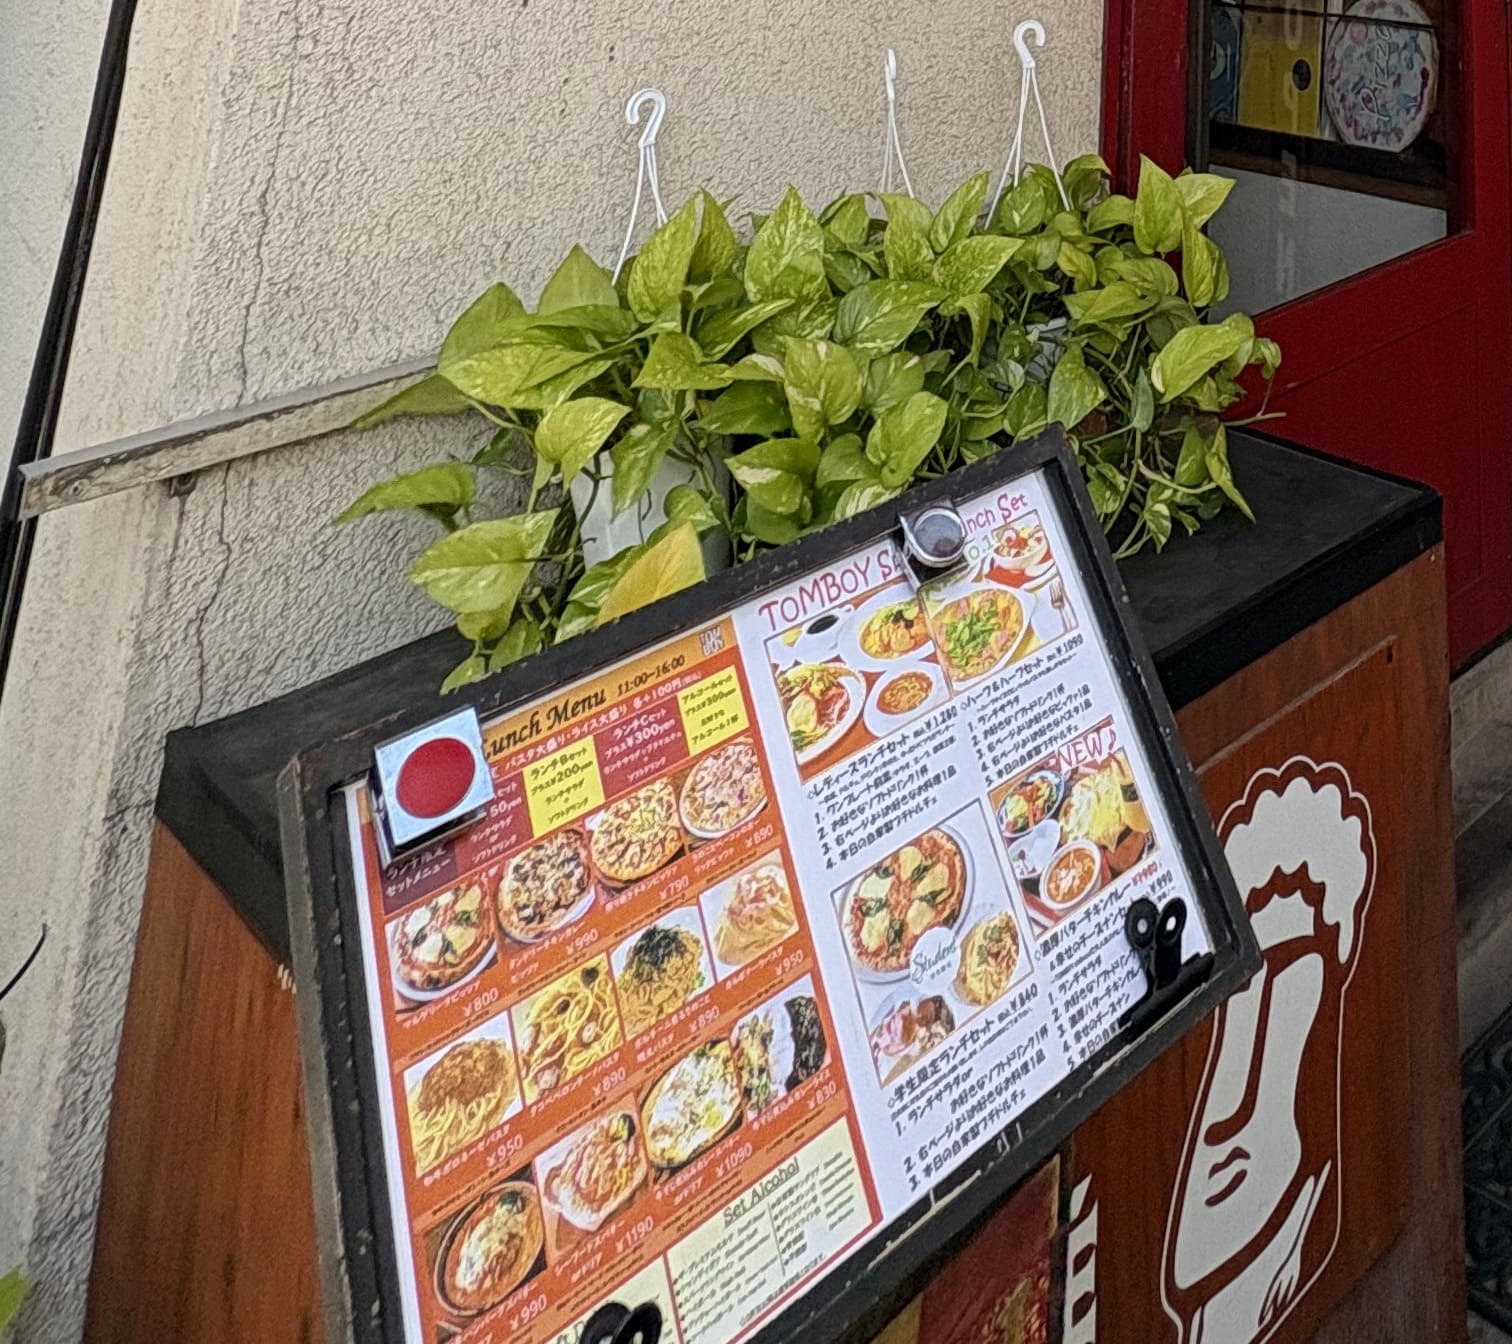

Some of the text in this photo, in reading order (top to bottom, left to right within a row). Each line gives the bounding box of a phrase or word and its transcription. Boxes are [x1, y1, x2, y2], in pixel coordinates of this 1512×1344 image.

[757, 551, 877, 635] TOMBOY
[995, 487, 1028, 524] Set
[544, 685, 606, 730] Menu
[812, 731, 910, 797] レディースランチセット
[1051, 726, 1108, 773] NEW
[659, 874, 689, 901] ¥790
[565, 926, 599, 956] ¥990
[774, 948, 804, 976] ¥950
[463, 987, 498, 1017] ¥800
[689, 1004, 720, 1033] ¥890
[892, 1015, 995, 1104] 学生限定ランチセット
[1009, 982, 1039, 1013] ¥840
[592, 1065, 626, 1098] ¥890
[807, 1079, 837, 1109] ¥830
[486, 1132, 524, 1169] ¥950
[715, 1141, 753, 1179] ¥1090
[720, 1196, 747, 1227] Set
[748, 1156, 799, 1205] Alcohol
[615, 1214, 654, 1254] ¥1190
[510, 1292, 547, 1331] ¥990
